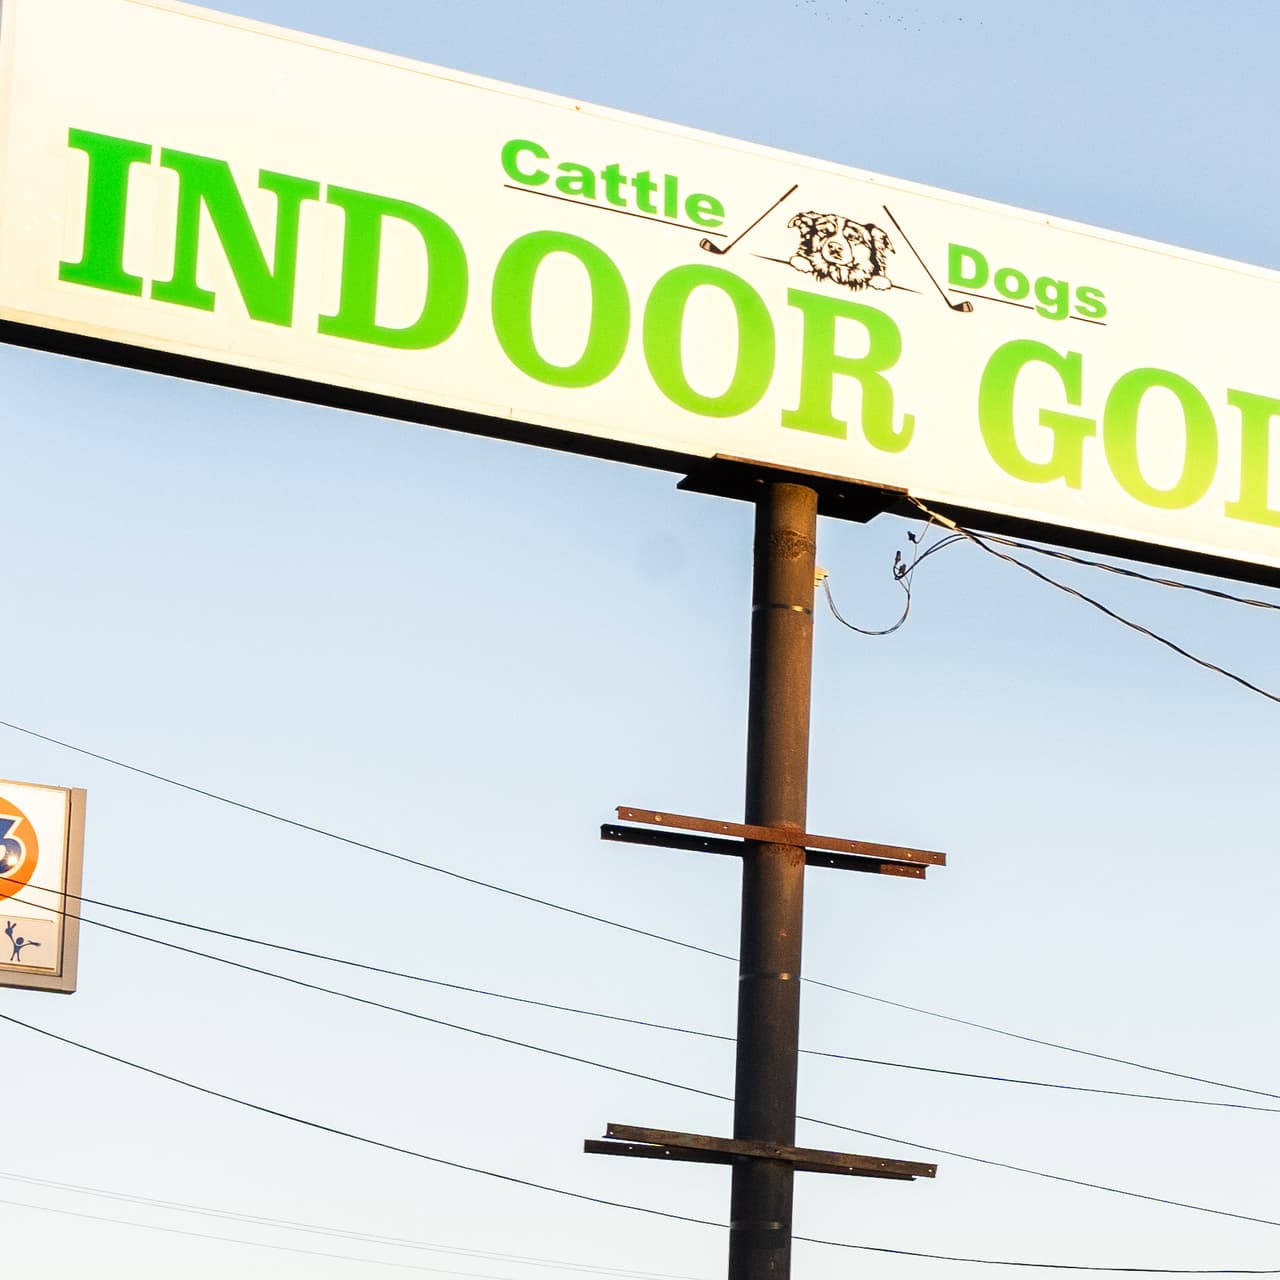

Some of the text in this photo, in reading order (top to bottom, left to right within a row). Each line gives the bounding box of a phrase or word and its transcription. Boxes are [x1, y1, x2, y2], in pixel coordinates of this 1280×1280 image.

[58, 127, 916, 454] INDOOR
[500, 138, 1108, 321] Cattle Dogs
